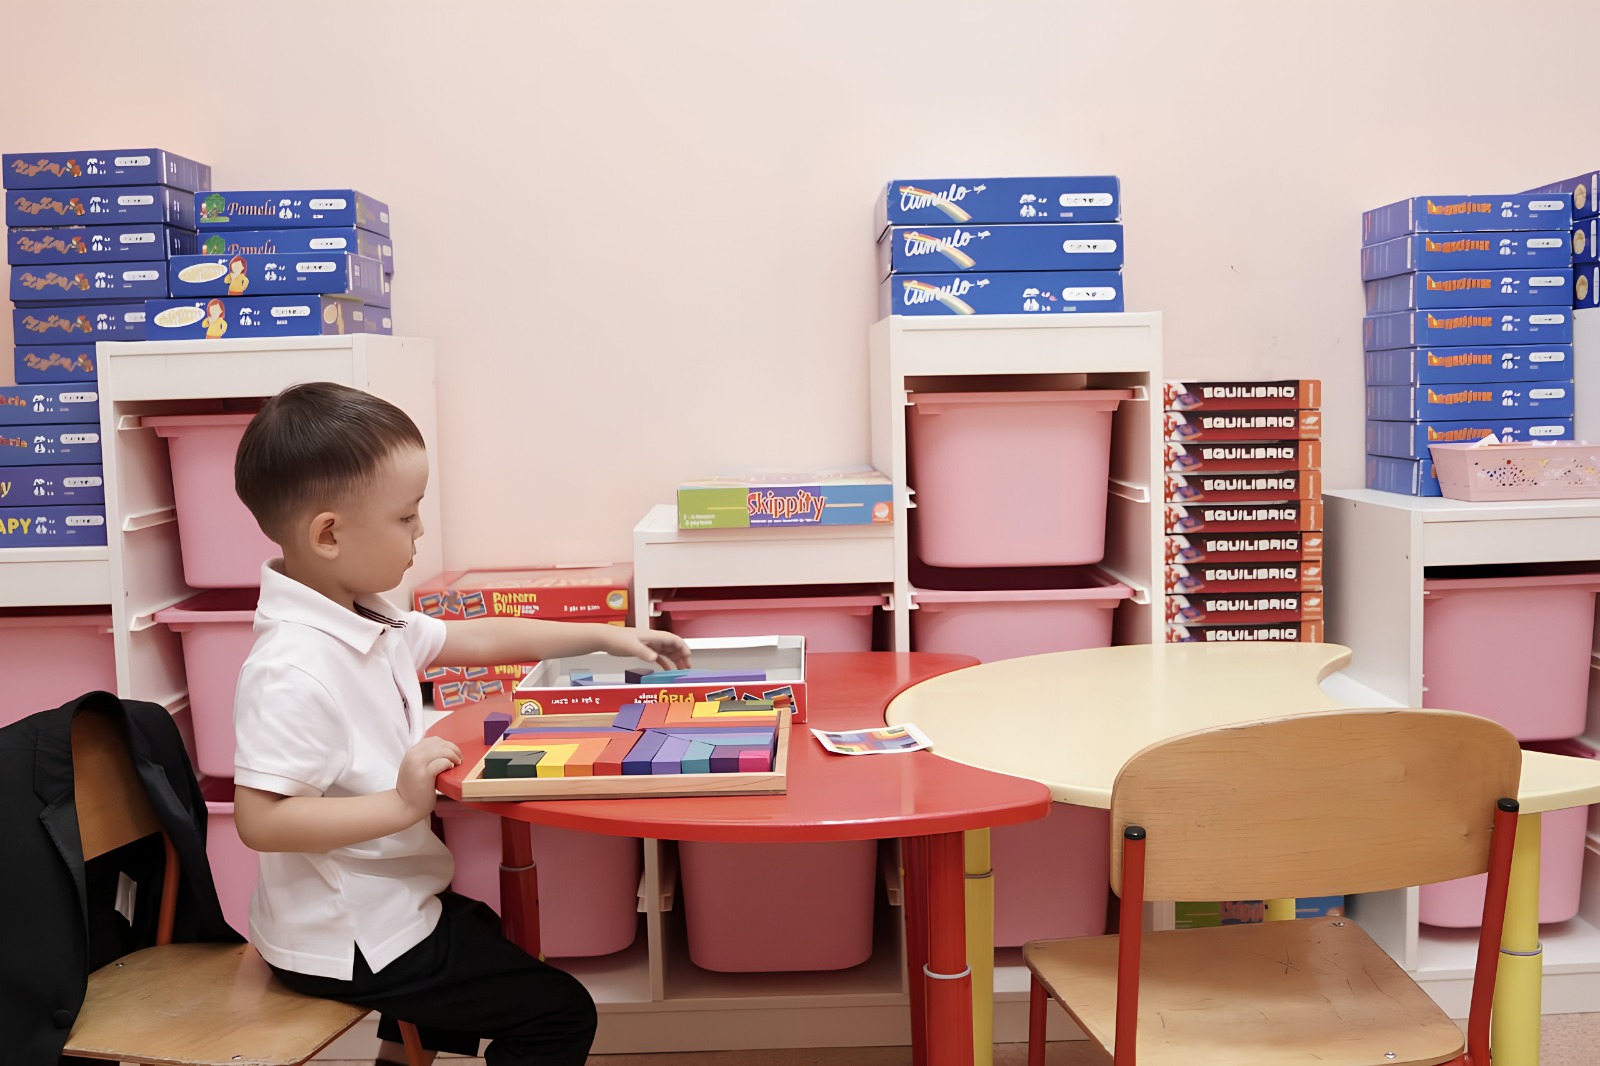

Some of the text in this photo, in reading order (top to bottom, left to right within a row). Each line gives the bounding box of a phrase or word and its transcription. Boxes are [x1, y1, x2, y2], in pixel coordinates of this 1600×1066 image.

[900, 183, 968, 212] Cumulo
[904, 229, 972, 257] Cumulo
[903, 277, 971, 306] Cumulo
[1203, 386, 1295, 398] EQUILIBRIO
[1203, 416, 1295, 429] EQUILIBRIO
[1203, 447, 1294, 460] EQUILIBRIO
[1203, 478, 1295, 491] EQUILIBRIO
[747, 490, 825, 521] Skippity
[1204, 509, 1296, 521] EQUILIBRIO
[1206, 539, 1298, 552] EQUILIBRIO
[1205, 568, 1297, 581] EQUILIBRIO
[1206, 599, 1297, 612] EQUILIBRIO
[1206, 629, 1297, 641] EQUILIBRIO
